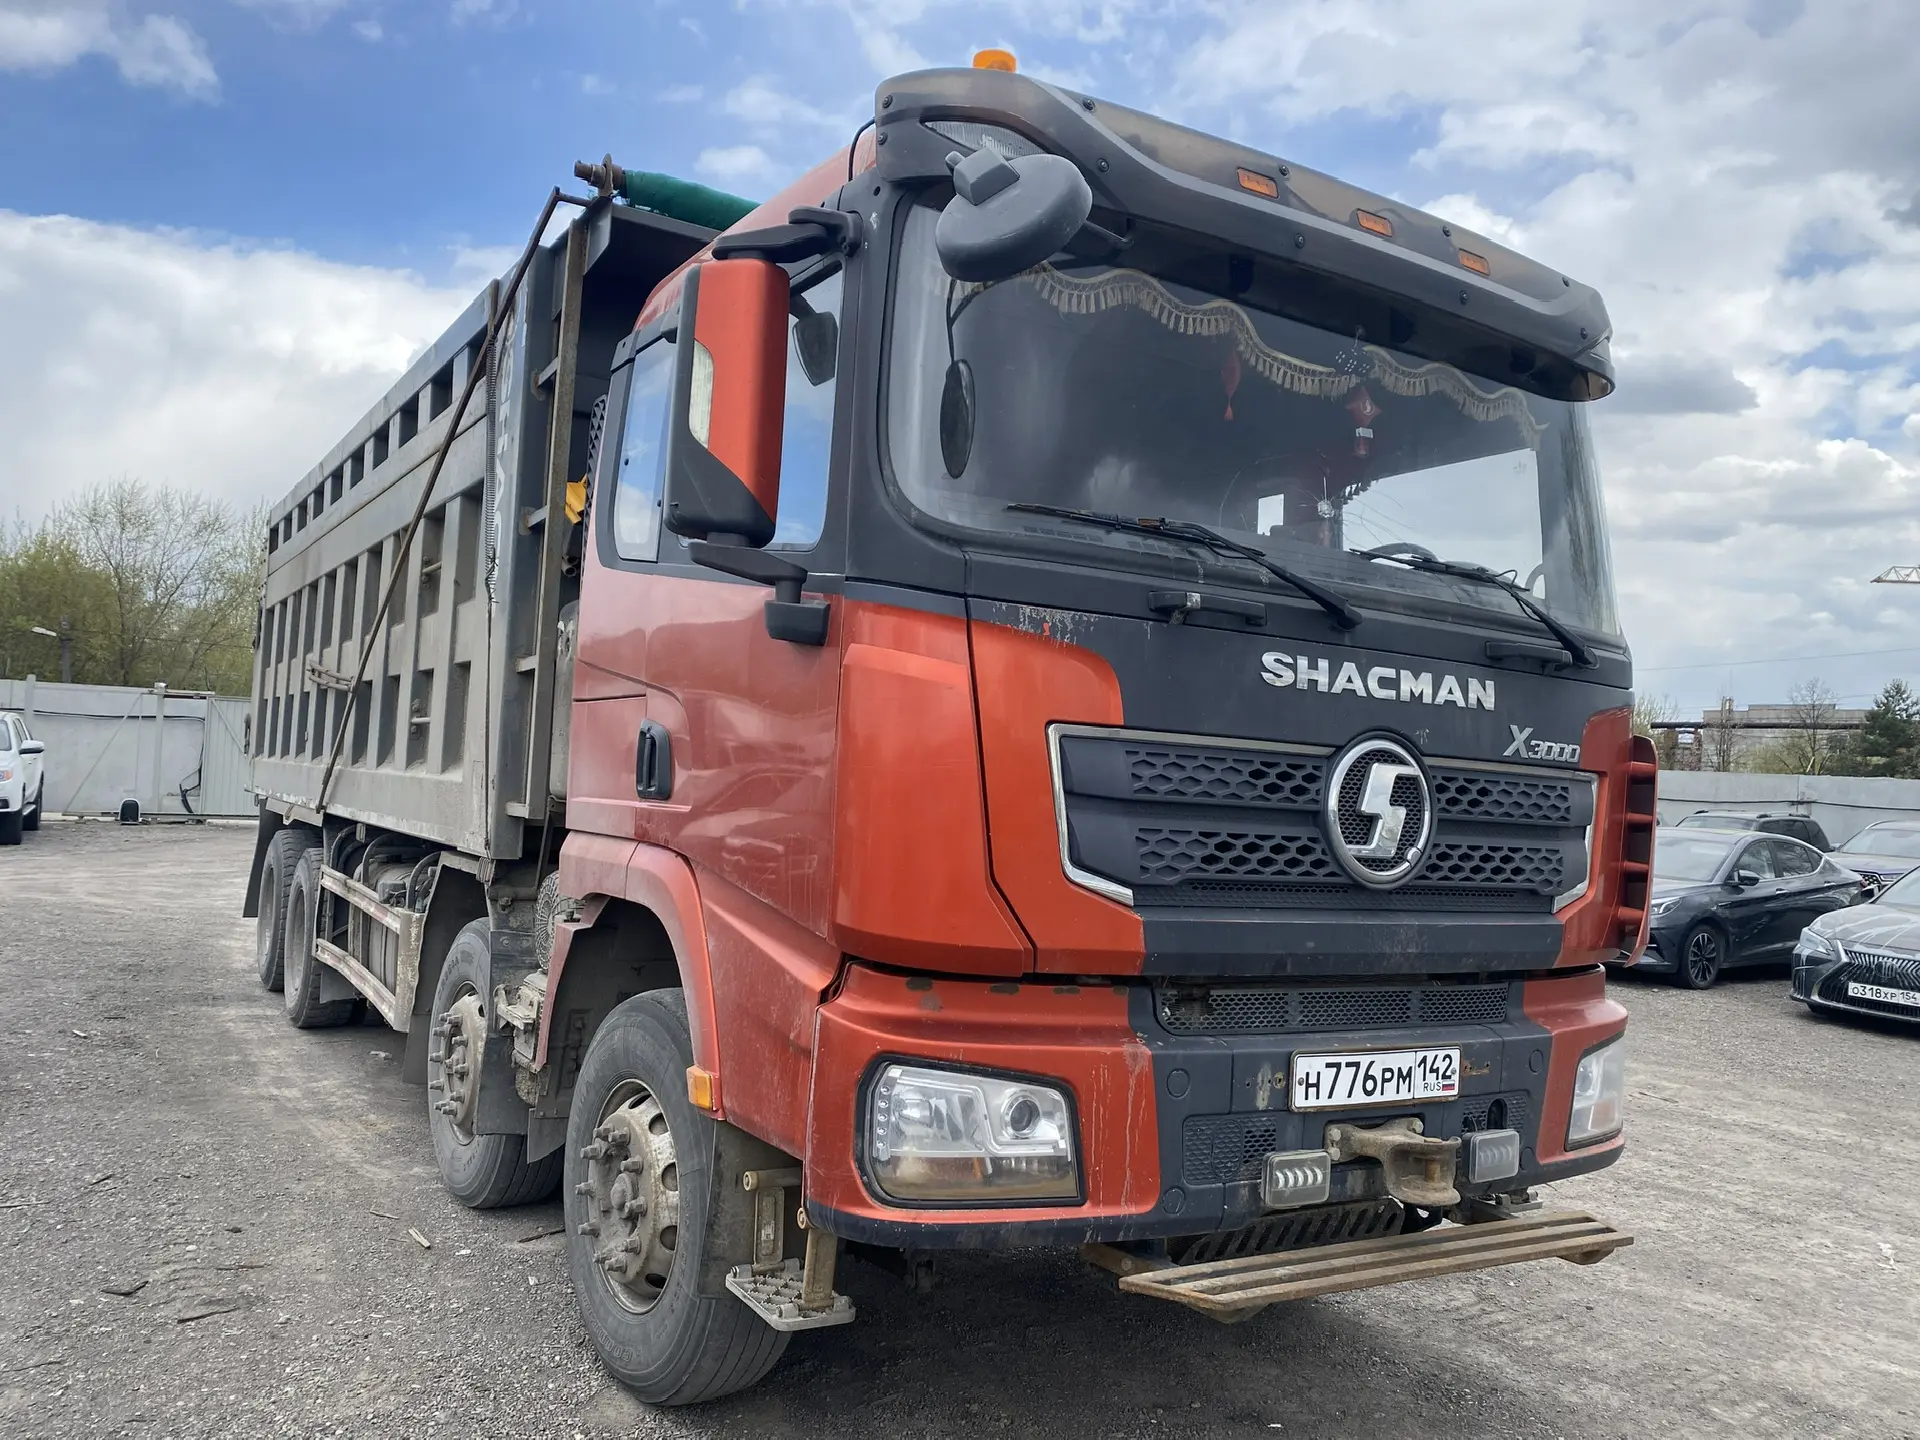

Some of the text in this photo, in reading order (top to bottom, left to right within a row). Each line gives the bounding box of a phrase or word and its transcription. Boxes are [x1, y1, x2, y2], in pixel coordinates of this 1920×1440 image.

[1260, 651, 1496, 712] SHACMAN
[1502, 724, 1580, 764] X3000
[1900, 991, 1917, 1002] 154
[1304, 1053, 1453, 1101] Н776РМ 142
[1423, 1081, 1442, 1092] RUS
